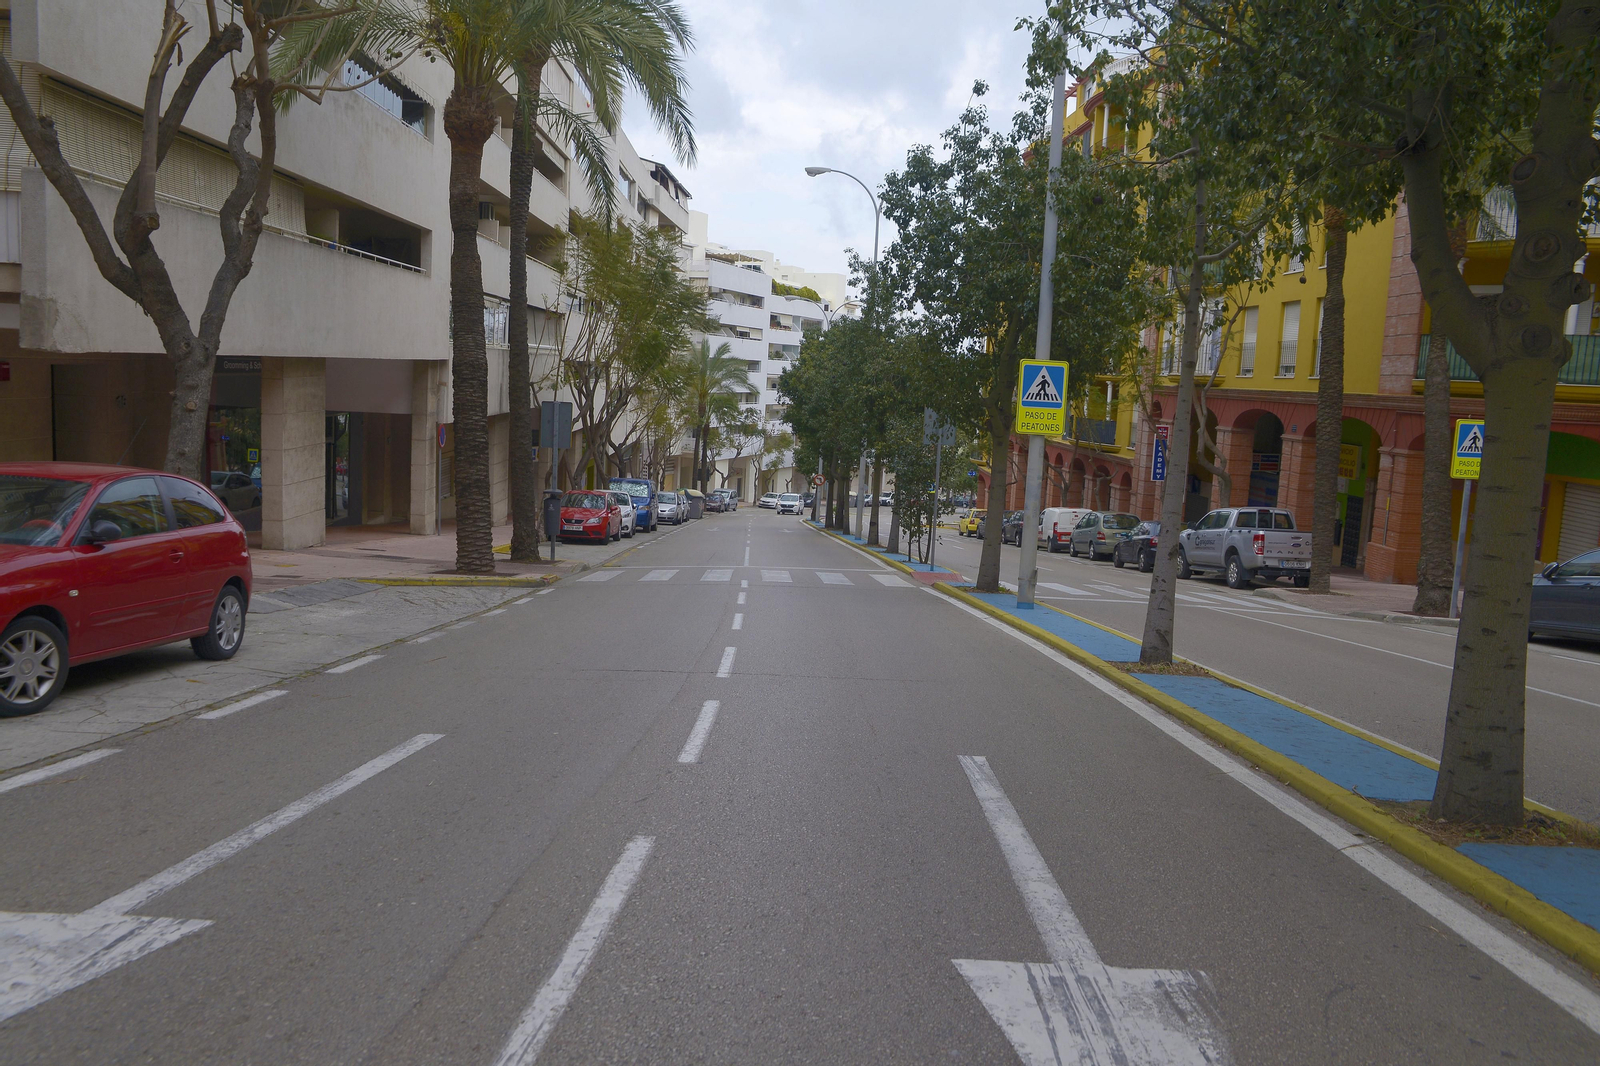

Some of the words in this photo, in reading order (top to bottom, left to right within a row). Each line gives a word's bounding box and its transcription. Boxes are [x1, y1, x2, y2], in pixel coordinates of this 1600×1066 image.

[1025, 411, 1045, 420] PASO
[1021, 422, 1060, 432] PEATONES
[1155, 441, 1163, 479] CADEMY
